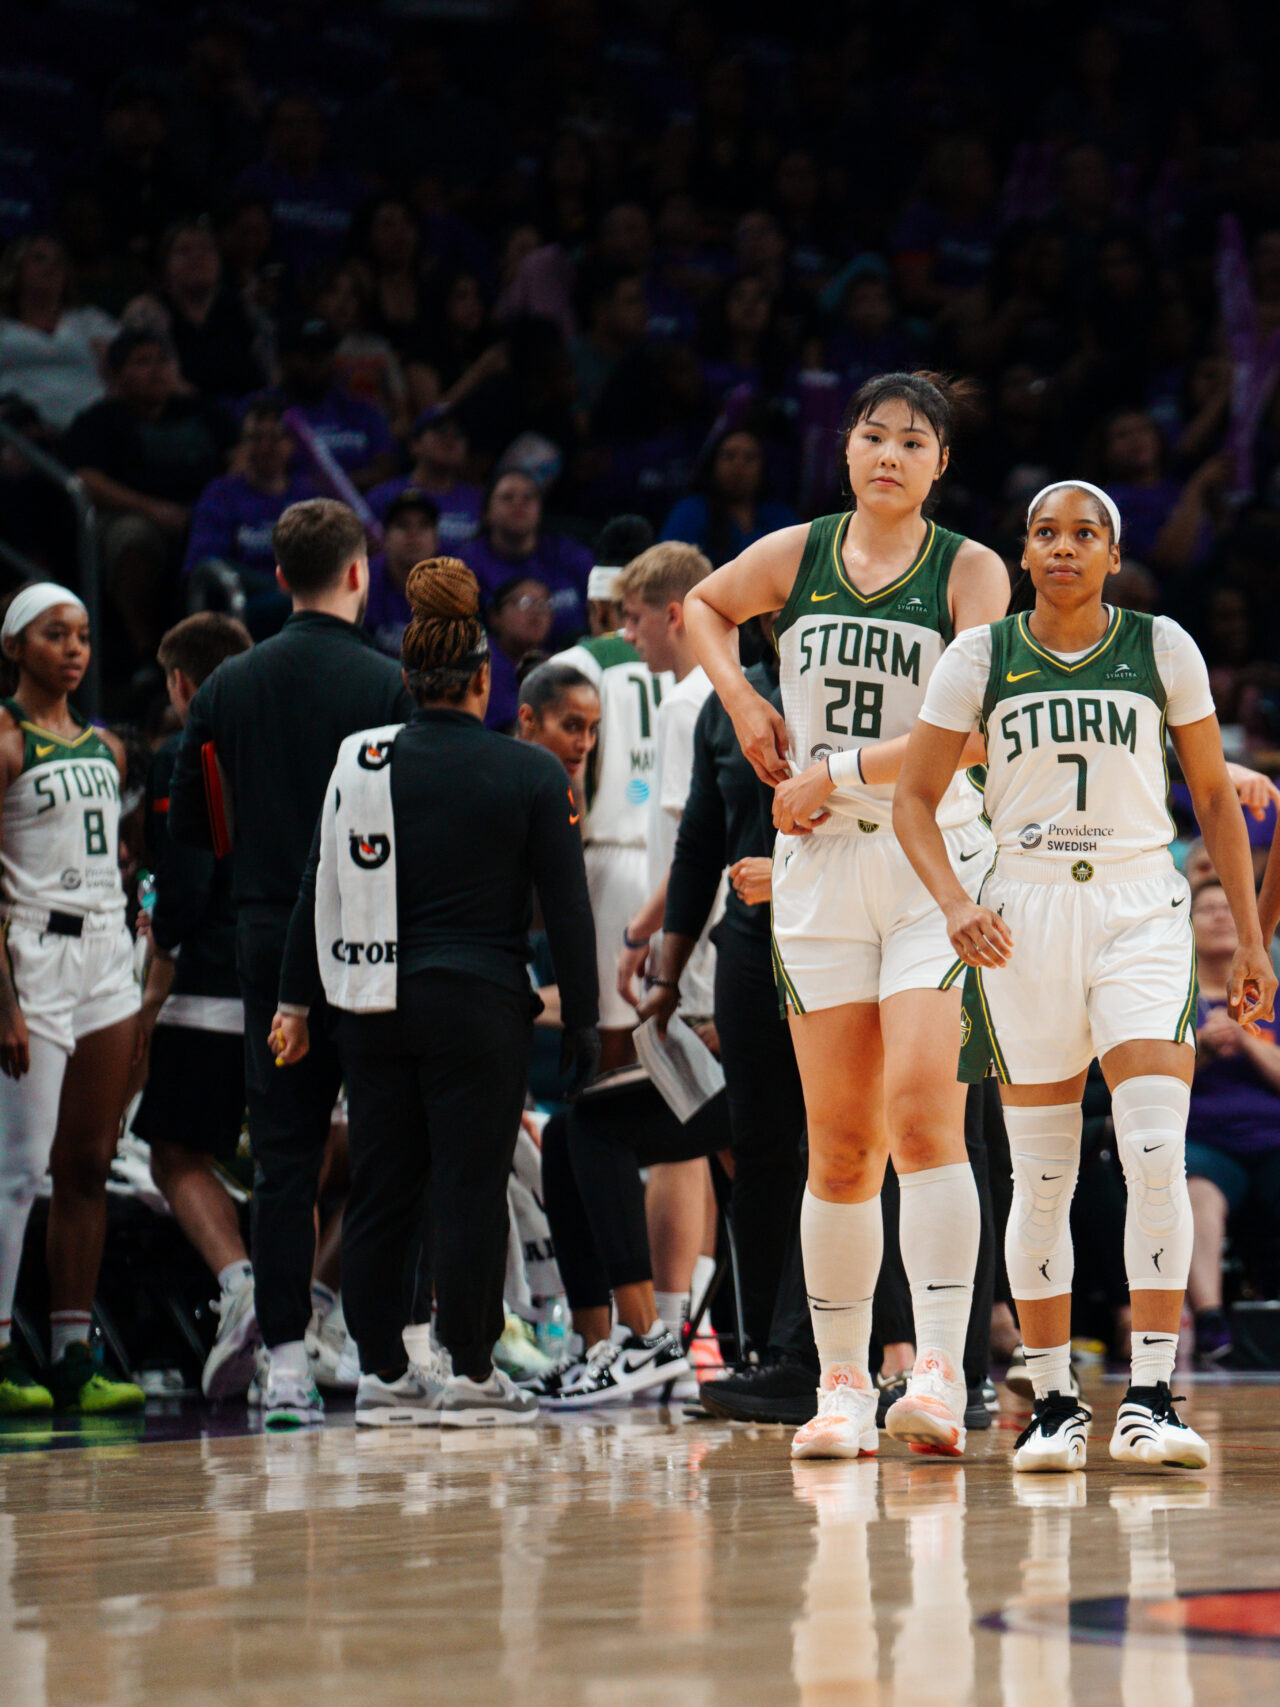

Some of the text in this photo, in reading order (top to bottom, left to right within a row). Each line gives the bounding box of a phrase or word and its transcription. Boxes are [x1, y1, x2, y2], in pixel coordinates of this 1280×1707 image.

[897, 604, 928, 613] SYMETRA
[800, 623, 921, 686] STORM
[1105, 671, 1137, 679] SYMETRA
[824, 678, 883, 738] 28
[1001, 698, 1137, 763] STORM
[1058, 754, 1087, 811] 7
[84, 810, 108, 855] 8
[1047, 841, 1097, 851] SWEDISH
[1048, 824, 1114, 837] Providence
